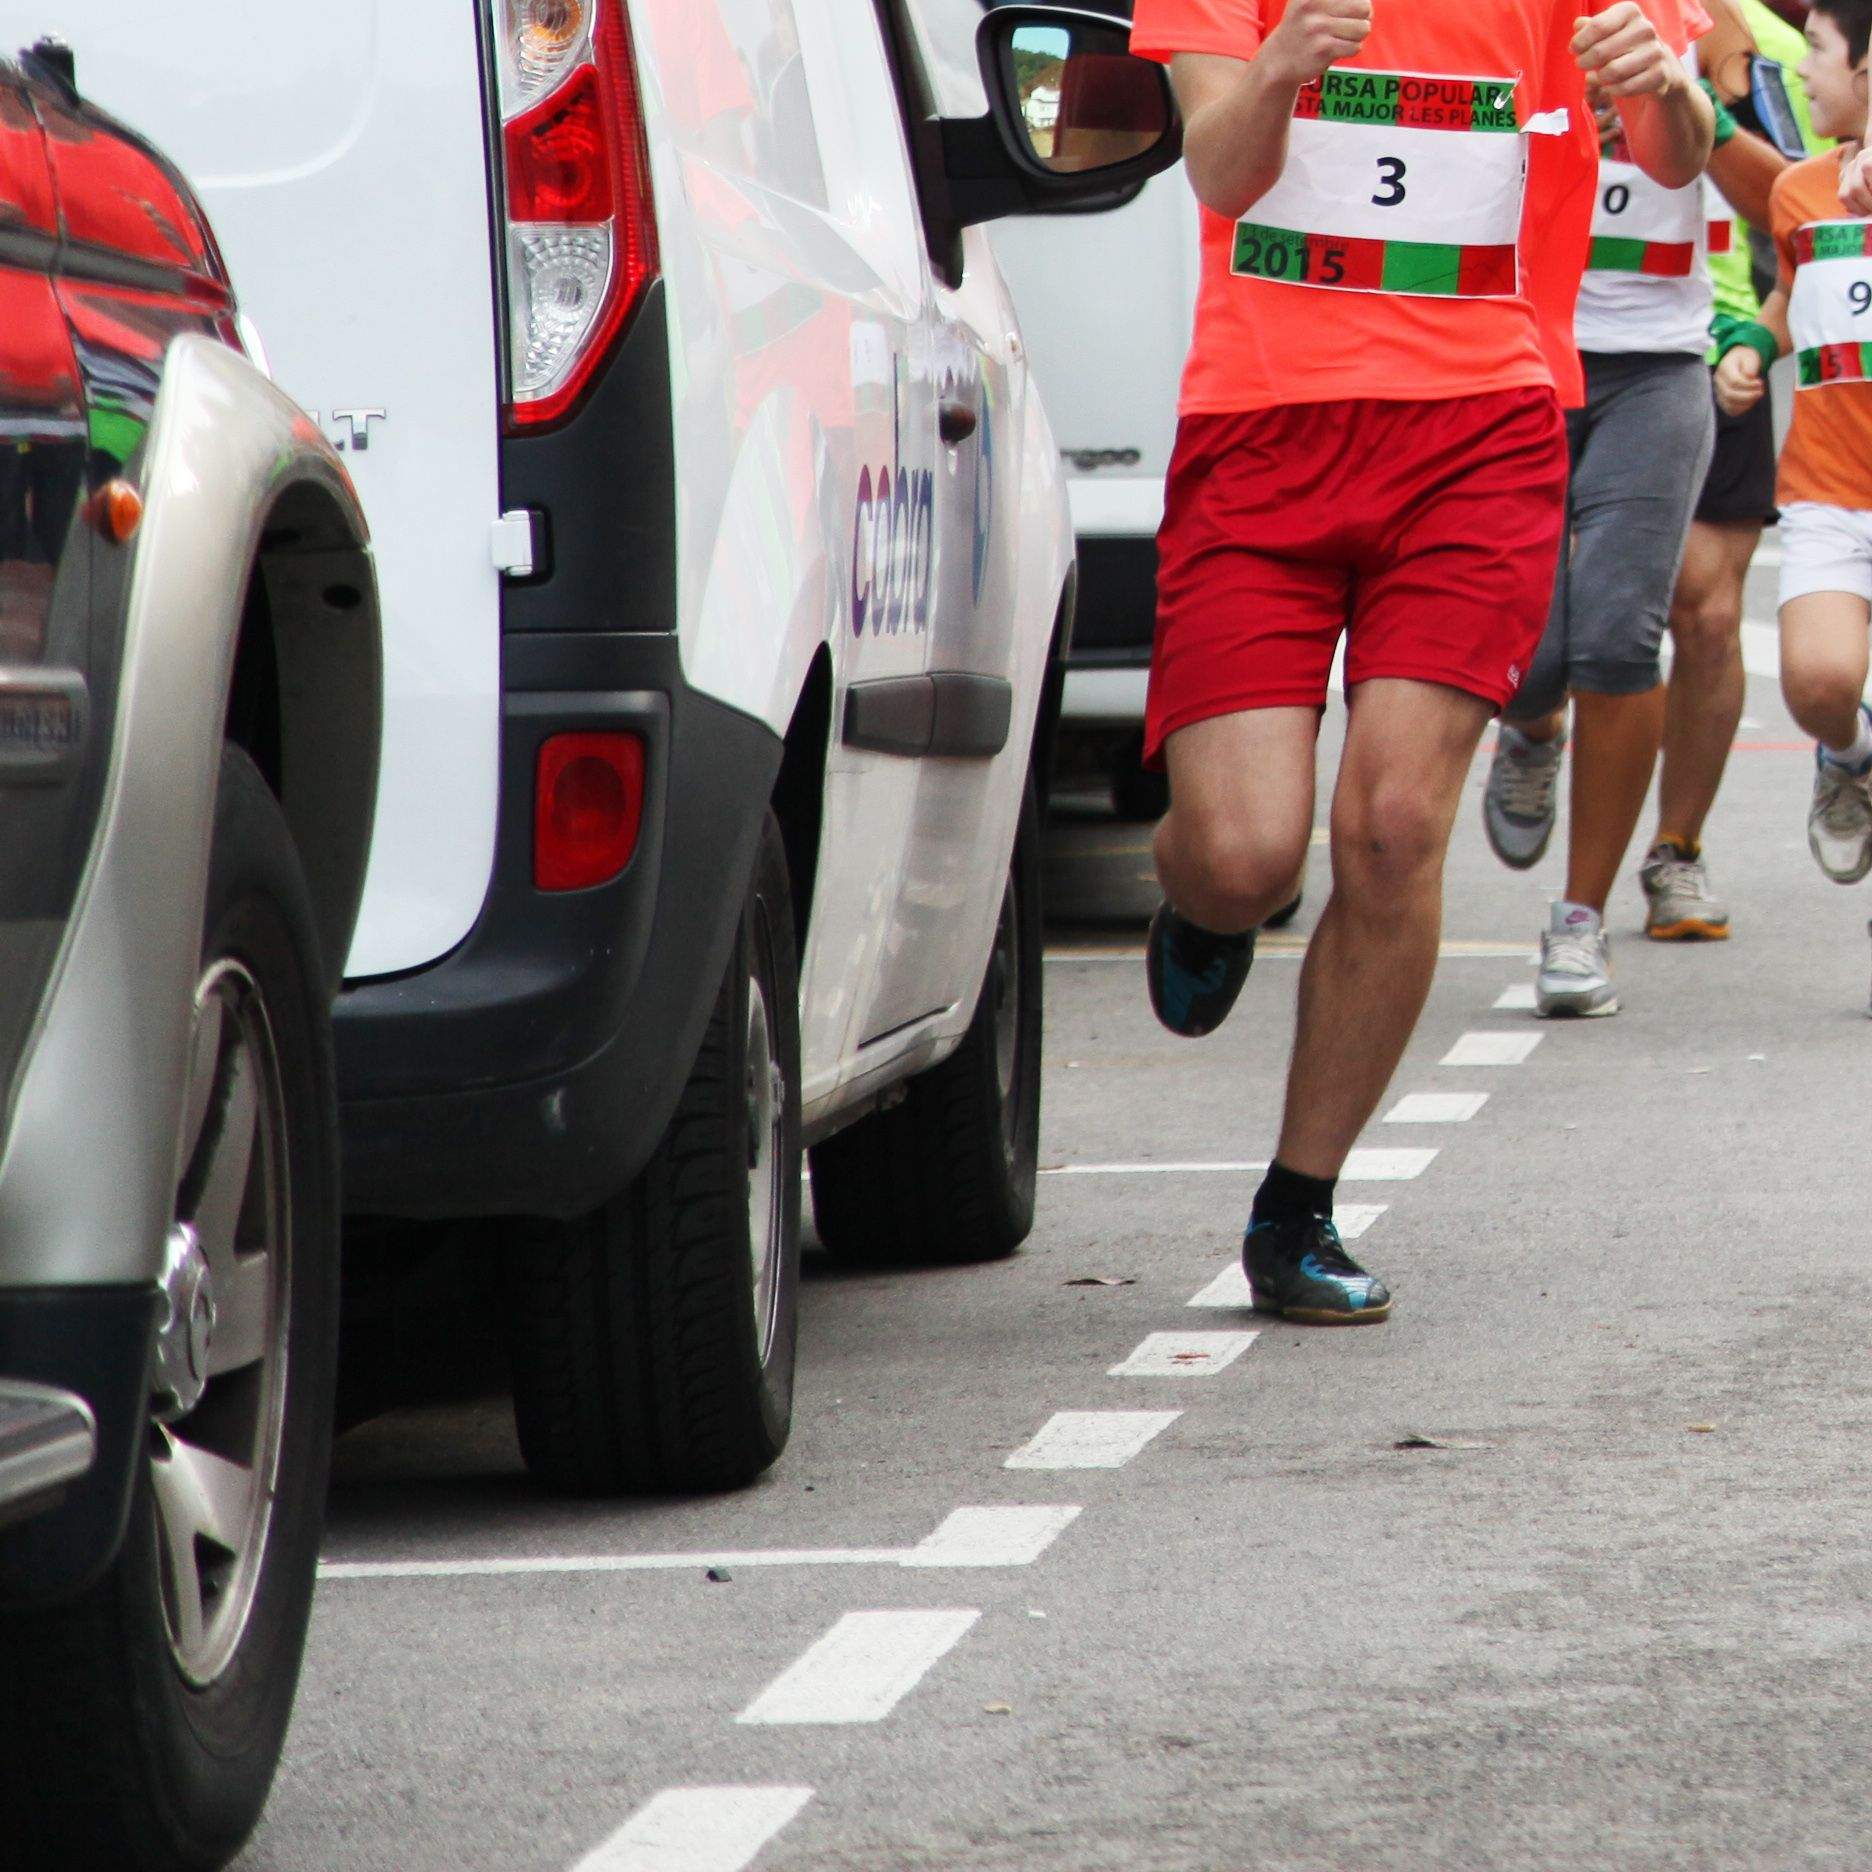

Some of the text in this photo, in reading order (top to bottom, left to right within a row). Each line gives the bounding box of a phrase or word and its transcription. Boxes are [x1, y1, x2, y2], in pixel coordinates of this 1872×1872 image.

[1384, 78, 1501, 108] POPULAR
[1295, 96, 1517, 128] STA MAJOR LES PLANES
[1371, 156, 1407, 207] 3
[1237, 236, 1346, 285] 2015
[1849, 281, 1872, 317] 9
